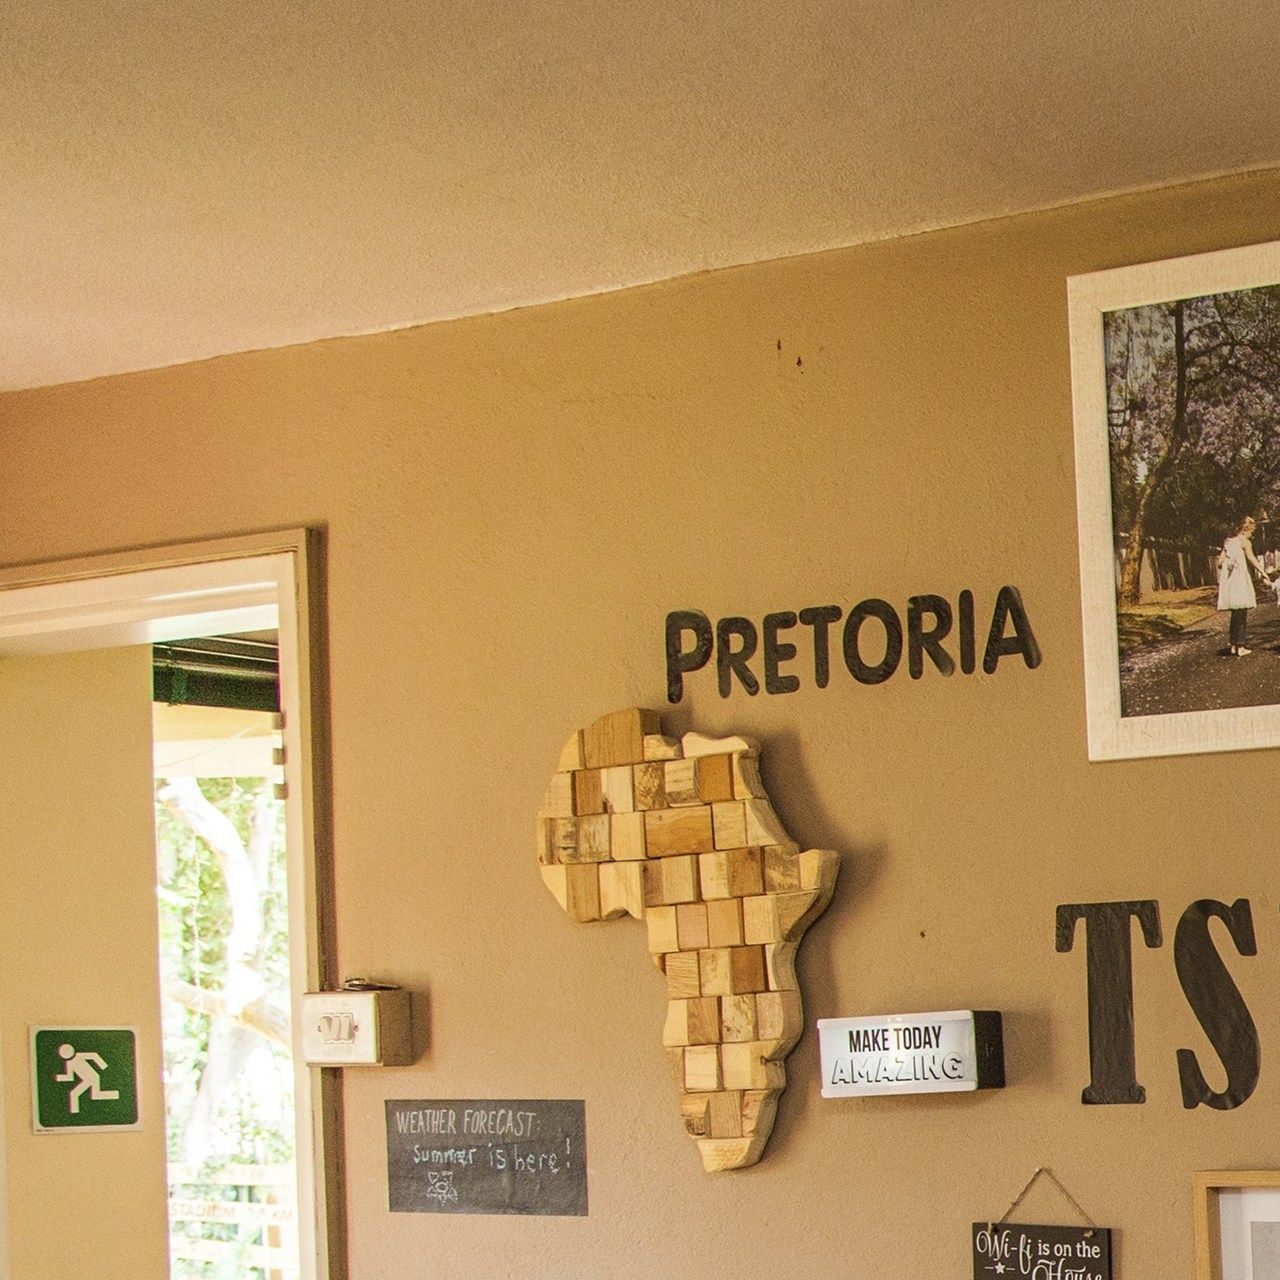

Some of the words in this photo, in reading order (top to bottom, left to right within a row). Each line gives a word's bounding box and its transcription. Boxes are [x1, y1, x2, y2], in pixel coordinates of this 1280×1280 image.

[665, 585, 1043, 704] PRETORIA
[849, 1028, 889, 1053] MAKE
[893, 1025, 942, 1051] TODAY
[831, 1050, 965, 1085] AMAZING
[396, 1108, 457, 1135] WEATHER
[413, 1144, 477, 1168] Summer
[488, 1142, 506, 1169] is
[976, 1229, 1033, 1275] Wi-fi
[1038, 1240, 1050, 1256] is
[1053, 1243, 1072, 1257] on
[1076, 1240, 1101, 1258] the
